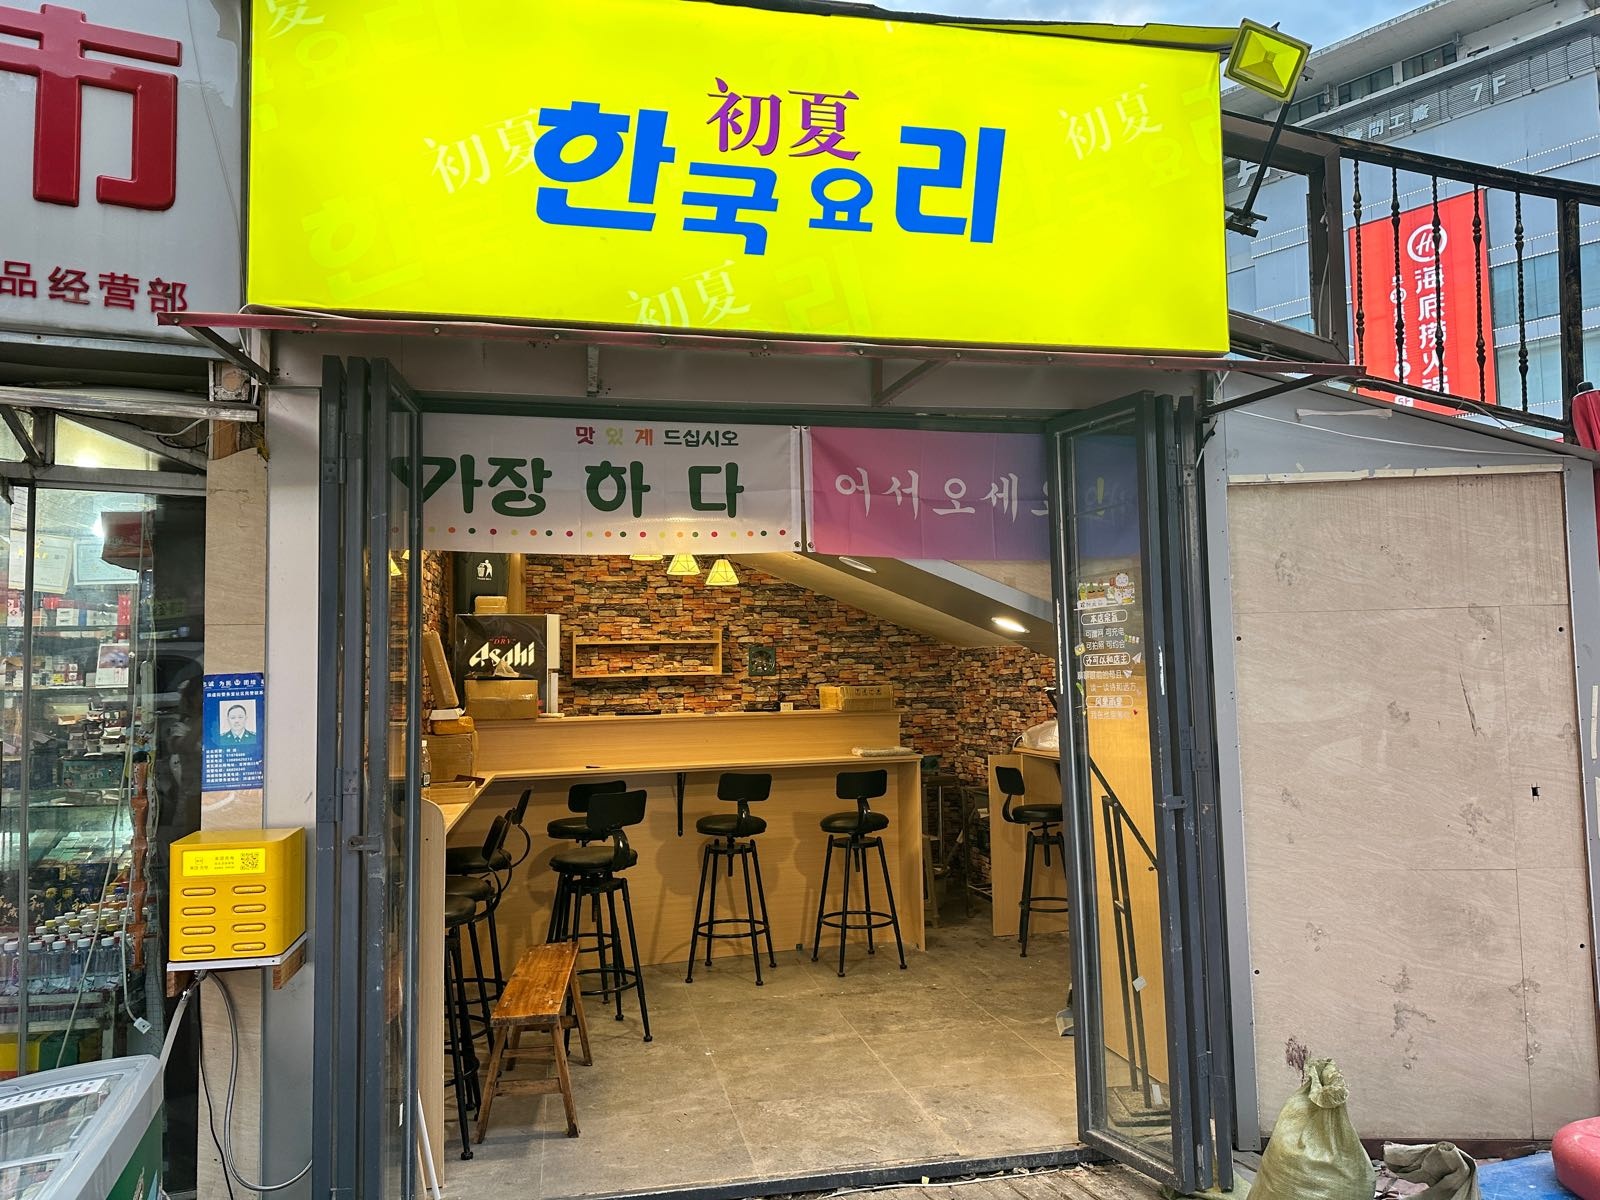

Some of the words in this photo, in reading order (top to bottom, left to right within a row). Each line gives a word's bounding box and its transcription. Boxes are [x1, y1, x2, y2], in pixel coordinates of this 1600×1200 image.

[707, 77, 861, 160] 初夏
[1058, 83, 1164, 161] 初夏
[533, 100, 1006, 255] 한국요리
[0, 260, 189, 312] 品经营部
[663, 429, 740, 449] 드십시오
[469, 640, 536, 668] Asahi
